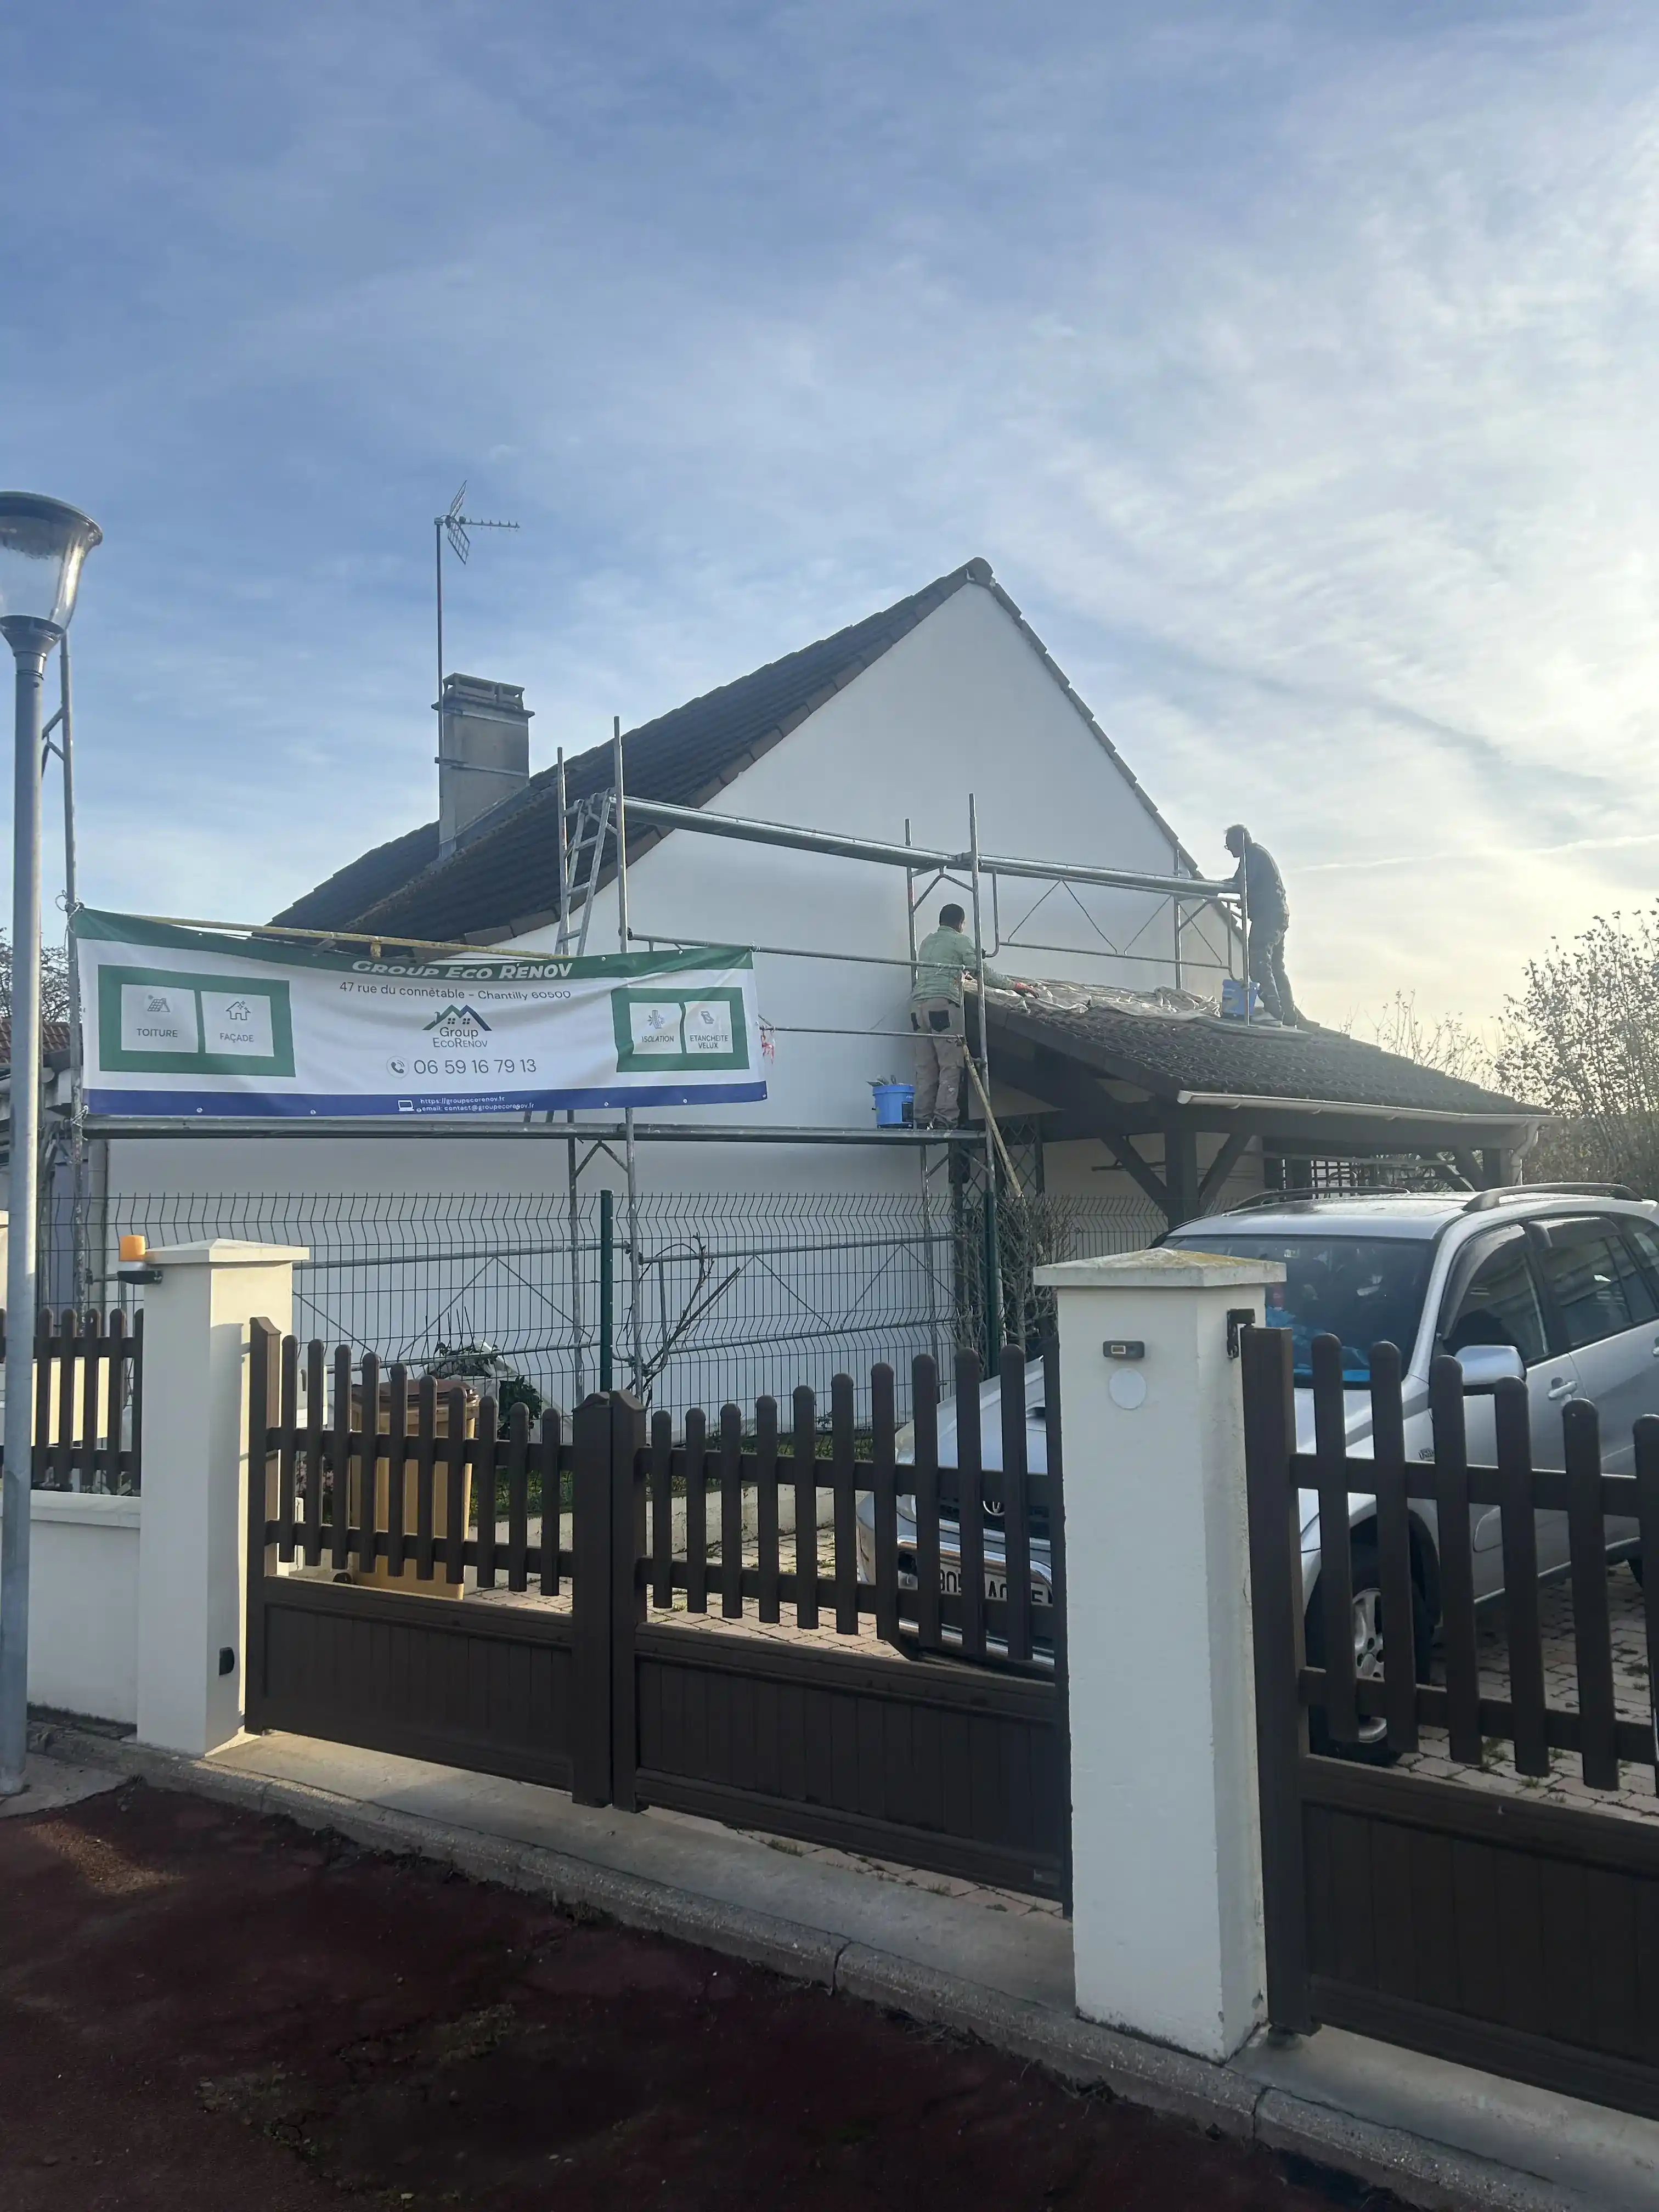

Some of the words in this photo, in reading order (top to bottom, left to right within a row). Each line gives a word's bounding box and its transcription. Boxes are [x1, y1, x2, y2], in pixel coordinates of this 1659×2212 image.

[352, 960, 439, 976] GROUP
[445, 967, 493, 979] ECO
[499, 963, 573, 979] RENOV
[340, 982, 354, 992] 47
[358, 985, 377, 993] rue
[381, 985, 395, 994] du
[478, 990, 528, 1000] Chantilly
[137, 1028, 178, 1037] TOITURE
[220, 1032, 253, 1043] FAÇADE
[439, 1026, 478, 1040] Group
[414, 1059, 438, 1074] 06
[445, 1059, 466, 1074] 59
[472, 1060, 489, 1073] 16
[494, 1059, 515, 1073] 79
[520, 1059, 537, 1072] 13
